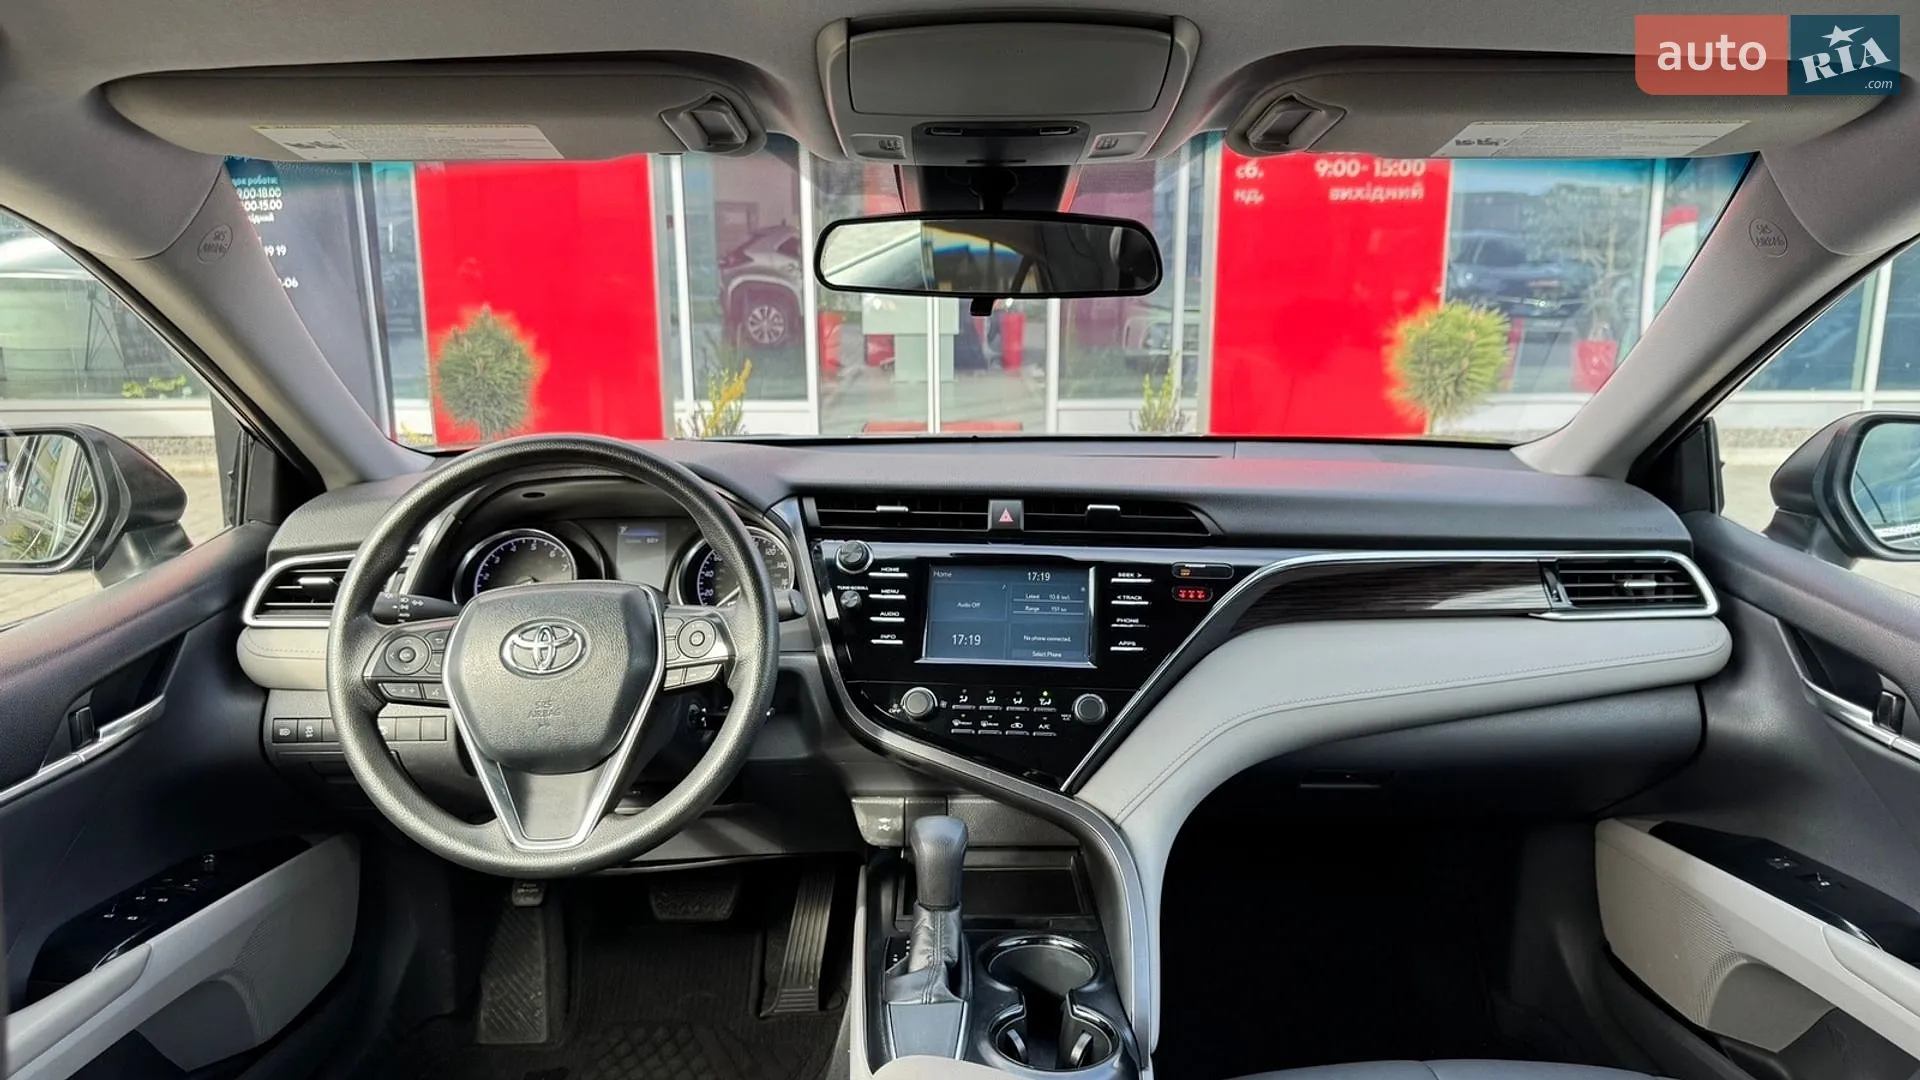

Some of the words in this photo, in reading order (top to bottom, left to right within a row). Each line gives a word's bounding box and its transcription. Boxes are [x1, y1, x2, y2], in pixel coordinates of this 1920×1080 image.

[1235, 162, 1264, 179] сб.
[1329, 182, 1424, 203] вихідний
[933, 570, 952, 578] Home
[1027, 572, 1050, 581] 17:19
[952, 634, 981, 646] 17:19
